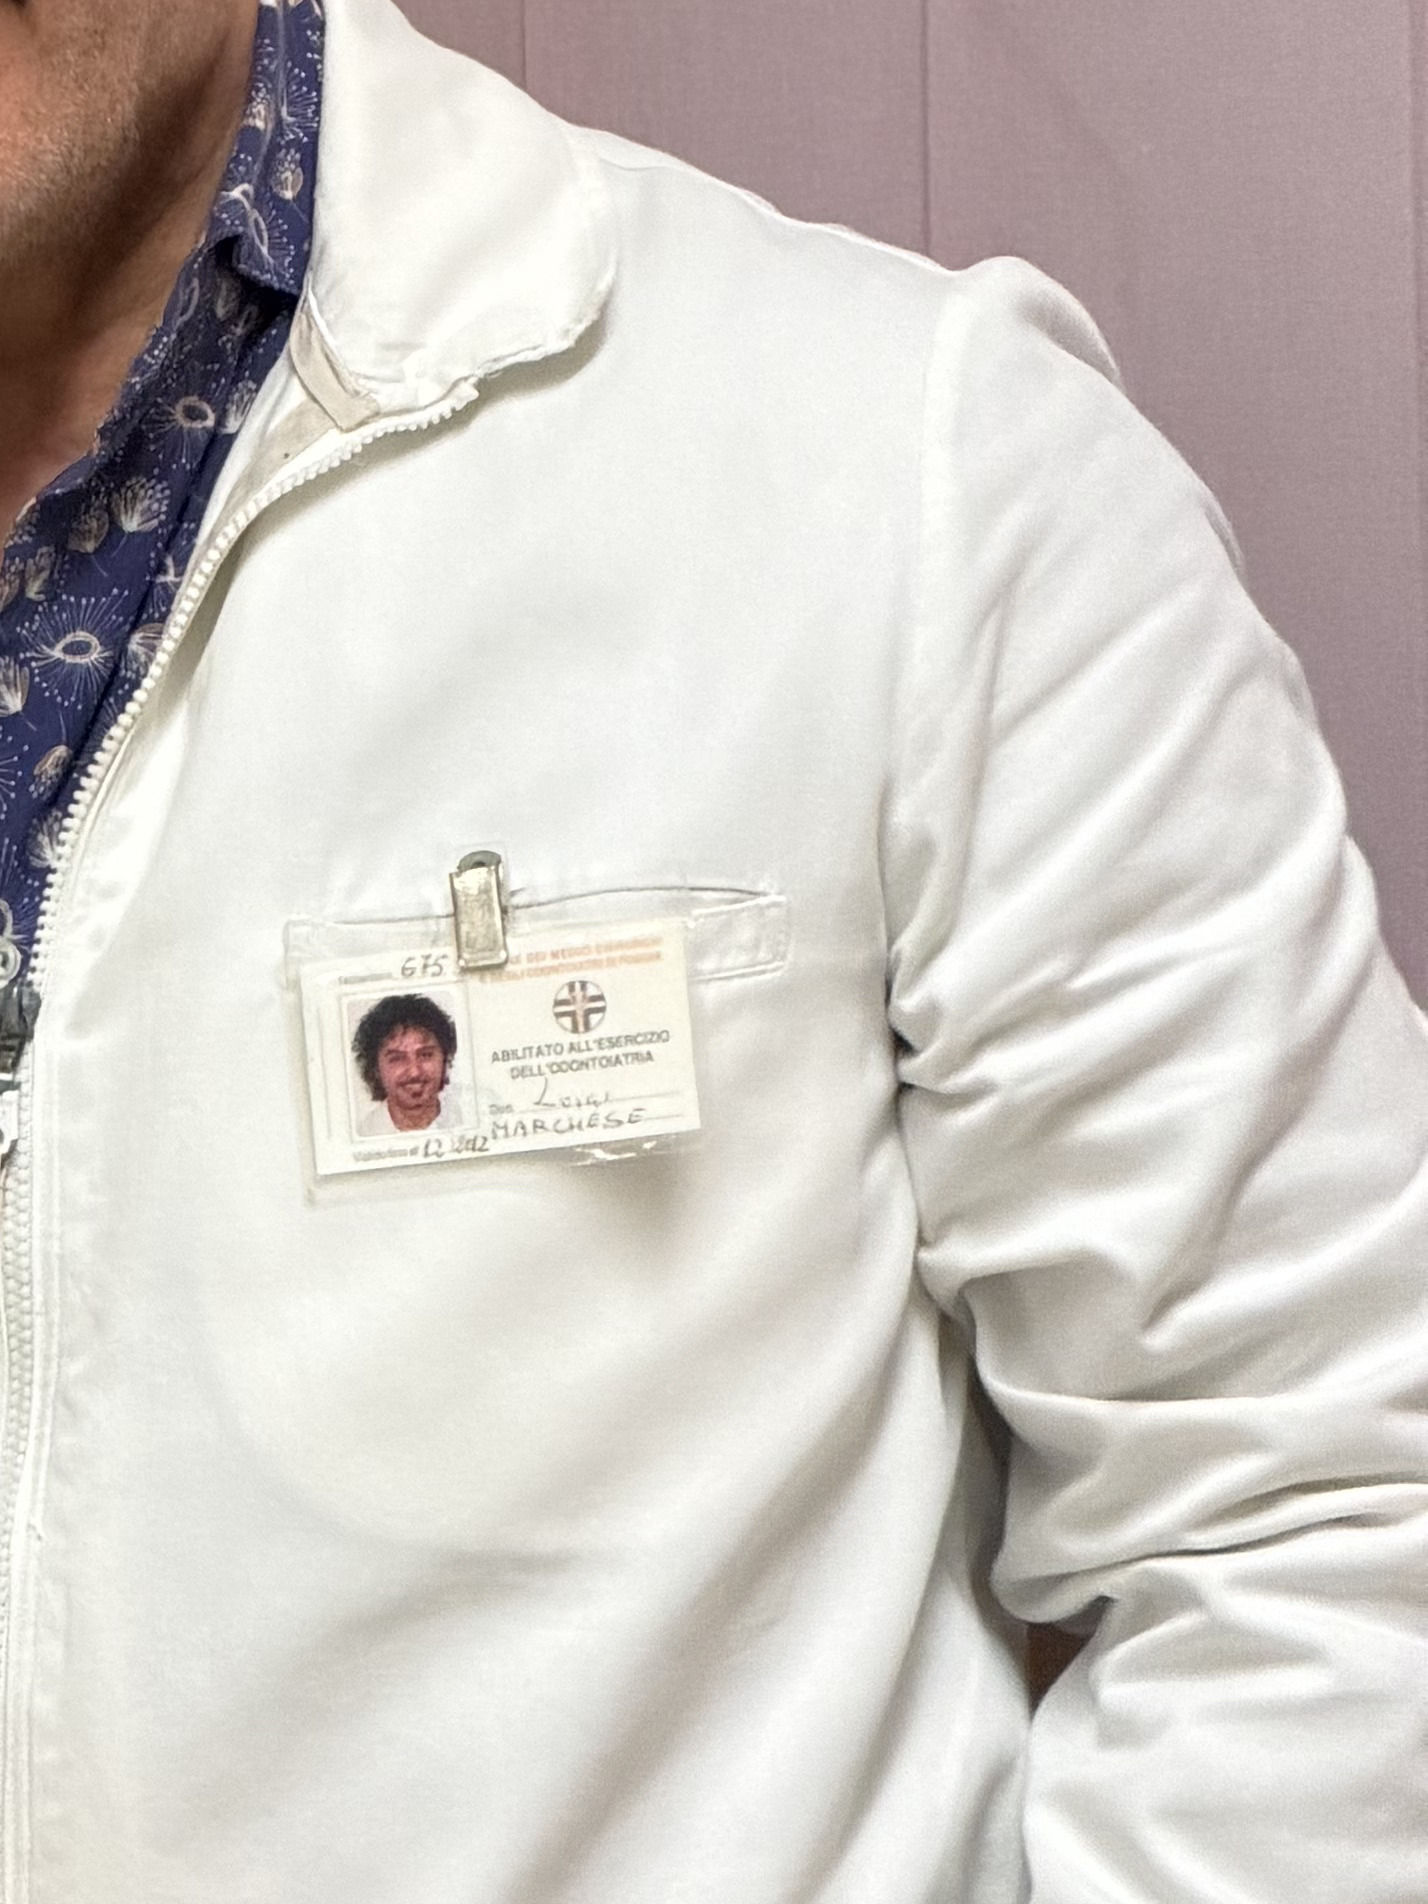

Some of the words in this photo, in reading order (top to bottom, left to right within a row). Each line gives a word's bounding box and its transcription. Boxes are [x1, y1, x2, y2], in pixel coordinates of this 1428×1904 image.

[491, 1044, 564, 1063] ABILITATO
[567, 1029, 671, 1055] ALL'ESERCIZIO
[510, 1049, 655, 1080] DELL'ODONTOIATRIA
[490, 1107, 646, 1141] MARCHESE
